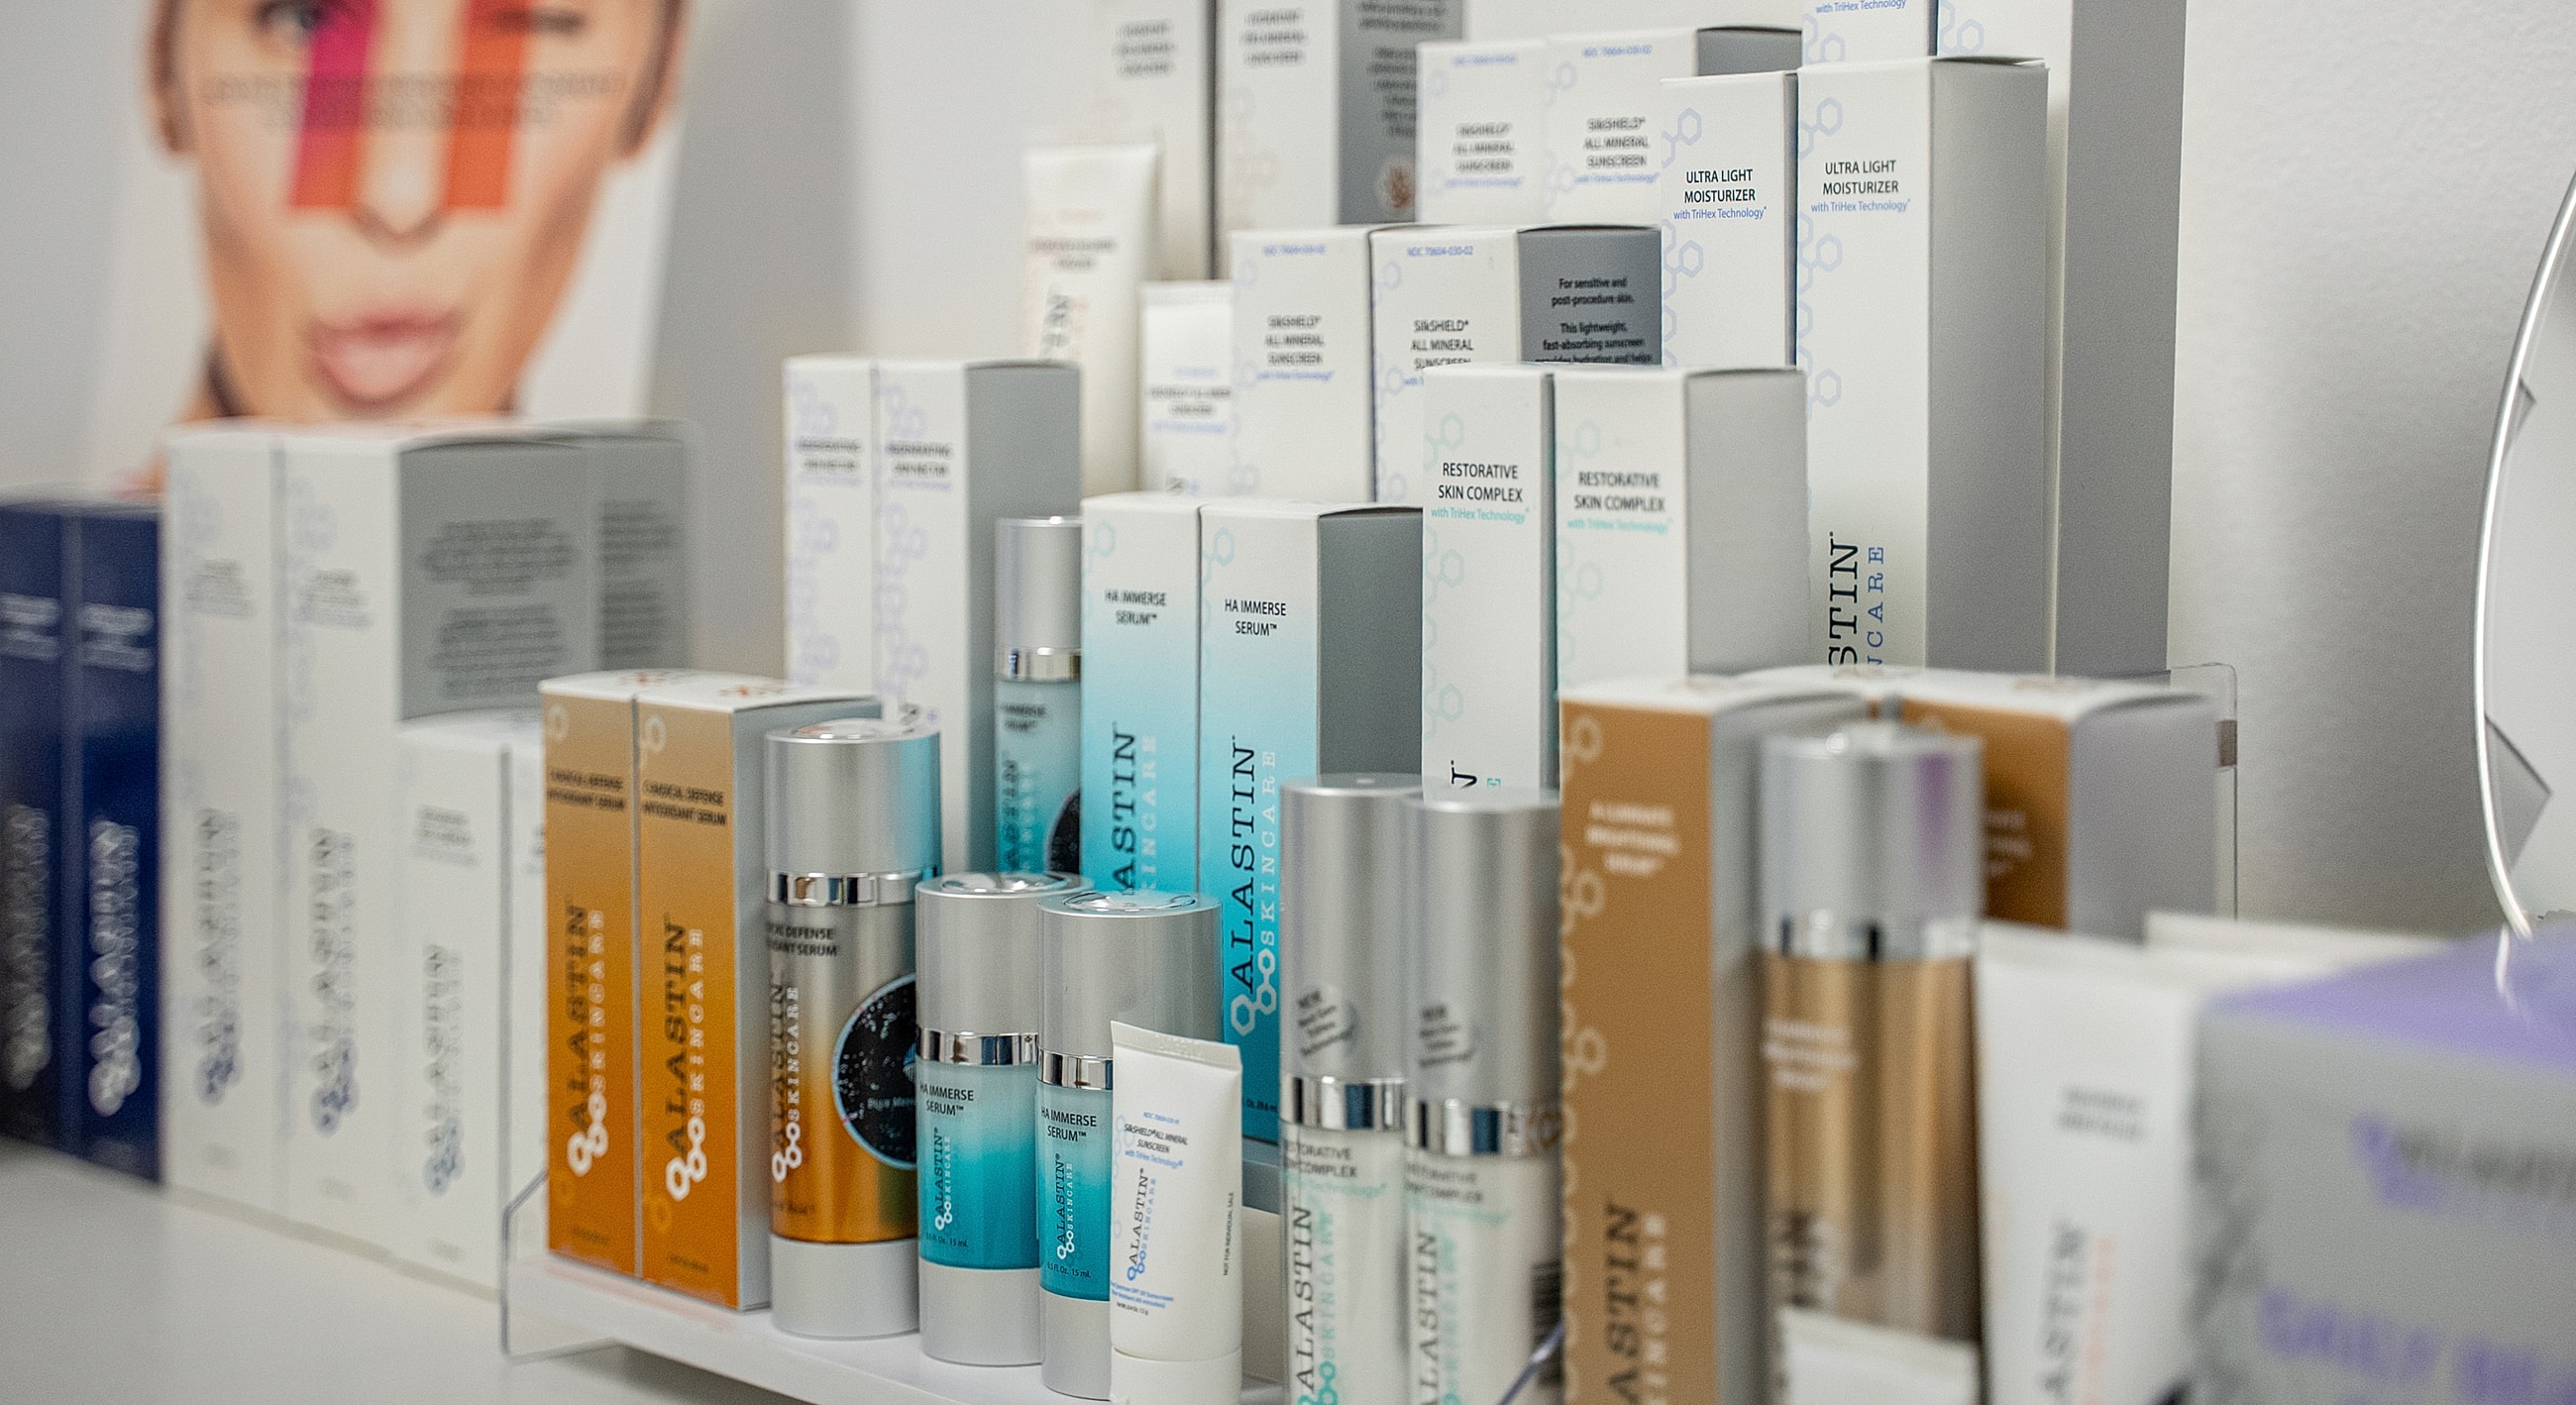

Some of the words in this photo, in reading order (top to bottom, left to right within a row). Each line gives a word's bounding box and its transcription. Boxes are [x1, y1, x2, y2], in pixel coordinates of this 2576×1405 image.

[1825, 161, 1860, 175] ULTRA
[1863, 160, 1896, 173] LIGHT
[1686, 169, 1720, 184] ULTRA
[1721, 168, 1754, 183] LIGHT
[1684, 188, 1756, 204] MOISTURIZER
[1822, 180, 1899, 196] MOISTURIZER
[1673, 208, 1690, 220] with
[1691, 208, 1717, 220] TriHex
[1810, 201, 1829, 213] with
[1830, 200, 1857, 212] TriHex
[1558, 277, 1572, 289] For
[1560, 322, 1577, 334] This
[1443, 462, 1519, 480] RESTORATIVE
[1578, 471, 1660, 488] RESTORATIVE
[1438, 485, 1464, 499] SKIN
[1466, 486, 1523, 502] COMPLEX
[1574, 494, 1601, 510] SKIN
[1605, 495, 1666, 512] COMPLEX
[1431, 506, 1449, 519] with
[1449, 506, 1475, 519] TriHex
[1225, 597, 1238, 613] HA
[1240, 599, 1287, 616] IMMERSE
[1260, 751, 1276, 946] SKINCARE
[1231, 741, 1255, 996] ALASTIN
[786, 925, 834, 940] DEFENSE
[797, 942, 837, 957] SERUM
[787, 987, 801, 1124] SKINCARE
[919, 1083, 929, 1096] HA
[929, 1086, 974, 1101] IMMERSE
[1041, 1108, 1050, 1122] HA
[1051, 1110, 1097, 1128] IMMERSE
[1136, 1138, 1170, 1153] SUNSCREEN
[1072, 1267, 1079, 1276] 15
[1080, 1270, 1091, 1279] mL
[1292, 1206, 1315, 1395] ALASTIN
